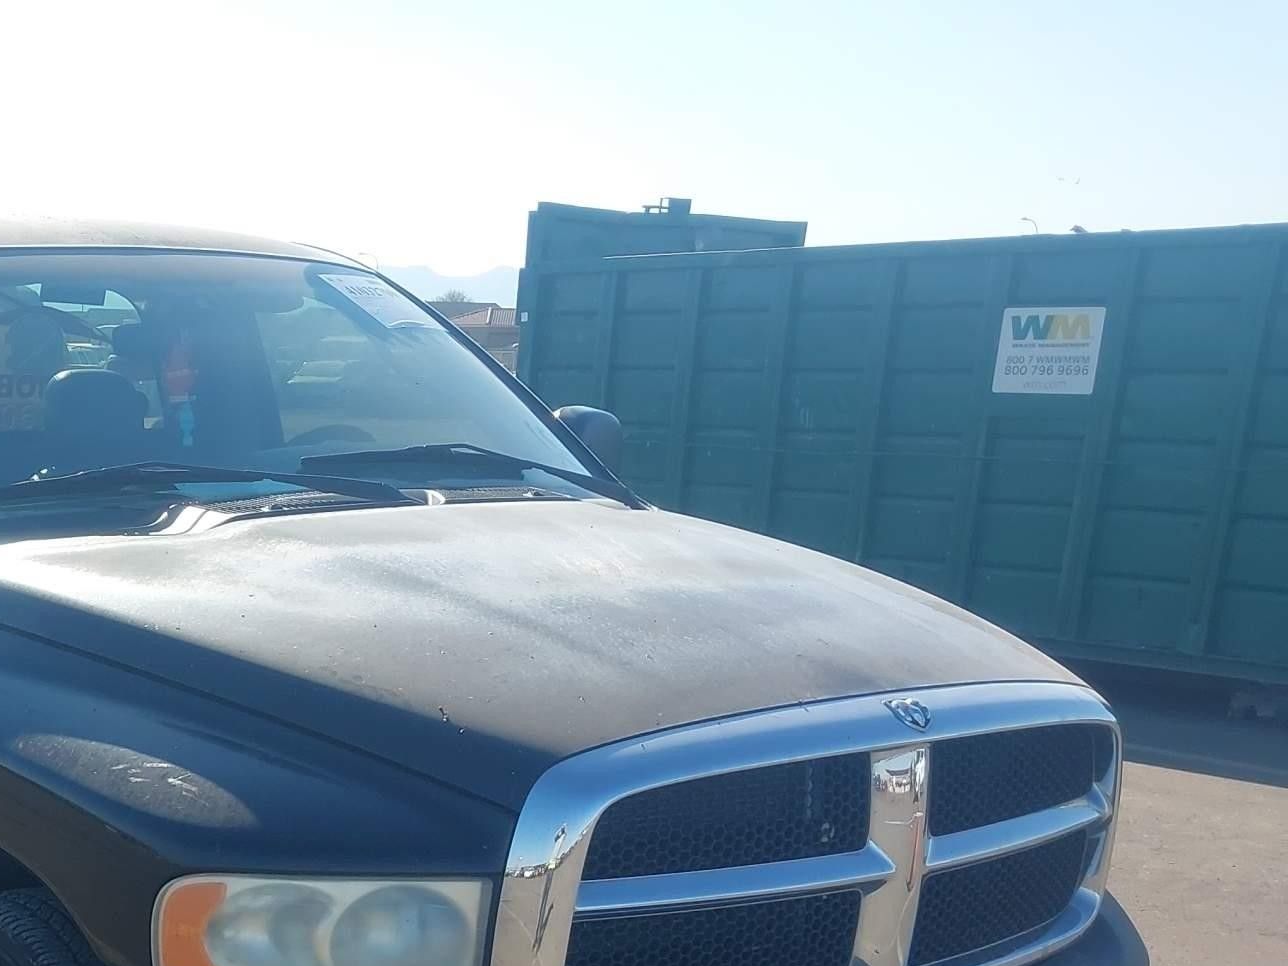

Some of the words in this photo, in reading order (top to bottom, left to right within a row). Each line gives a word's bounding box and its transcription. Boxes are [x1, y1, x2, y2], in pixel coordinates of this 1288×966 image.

[1011, 314, 1091, 340] WM
[1004, 365, 1027, 376] 800
[1031, 365, 1054, 376] 796
[1057, 365, 1089, 376] 9696
